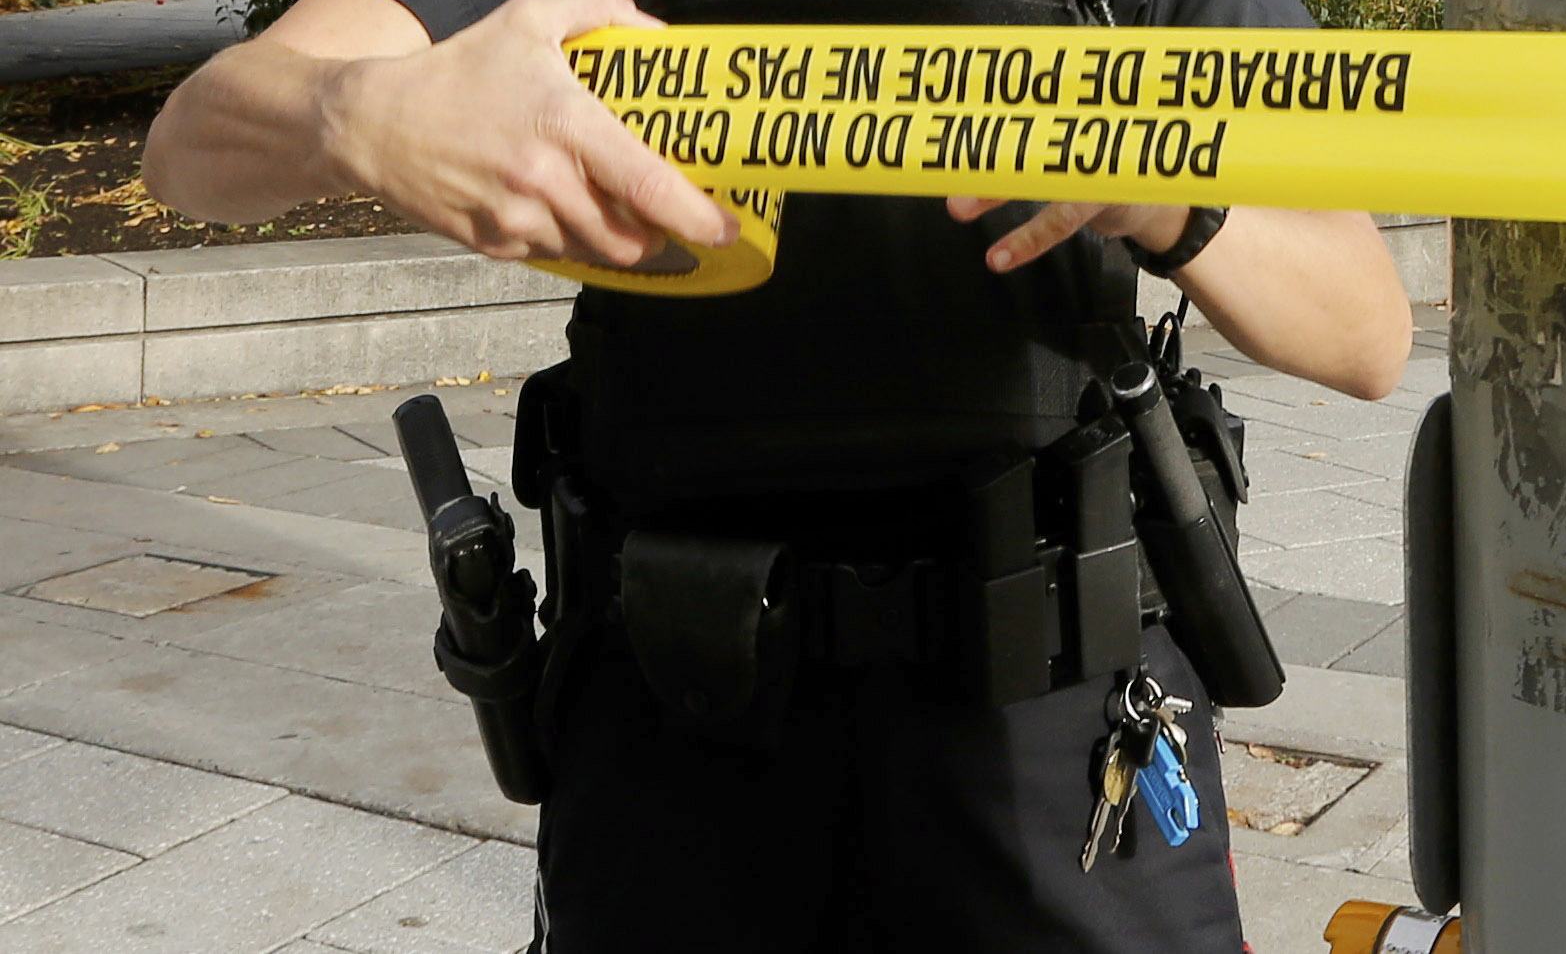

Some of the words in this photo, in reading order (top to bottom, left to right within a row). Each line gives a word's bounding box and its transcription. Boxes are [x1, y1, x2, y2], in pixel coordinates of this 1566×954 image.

[569, 47, 709, 100] TRAVE
[725, 46, 813, 100] PAS
[821, 47, 886, 102] NE
[895, 47, 1066, 105] POLICE
[1077, 49, 1146, 107] DE
[1157, 50, 1411, 113] BARRAGE
[741, 111, 835, 168] NOT
[845, 112, 913, 169] DO
[921, 115, 1035, 173] LINE
[1043, 117, 1227, 179] POLICE
